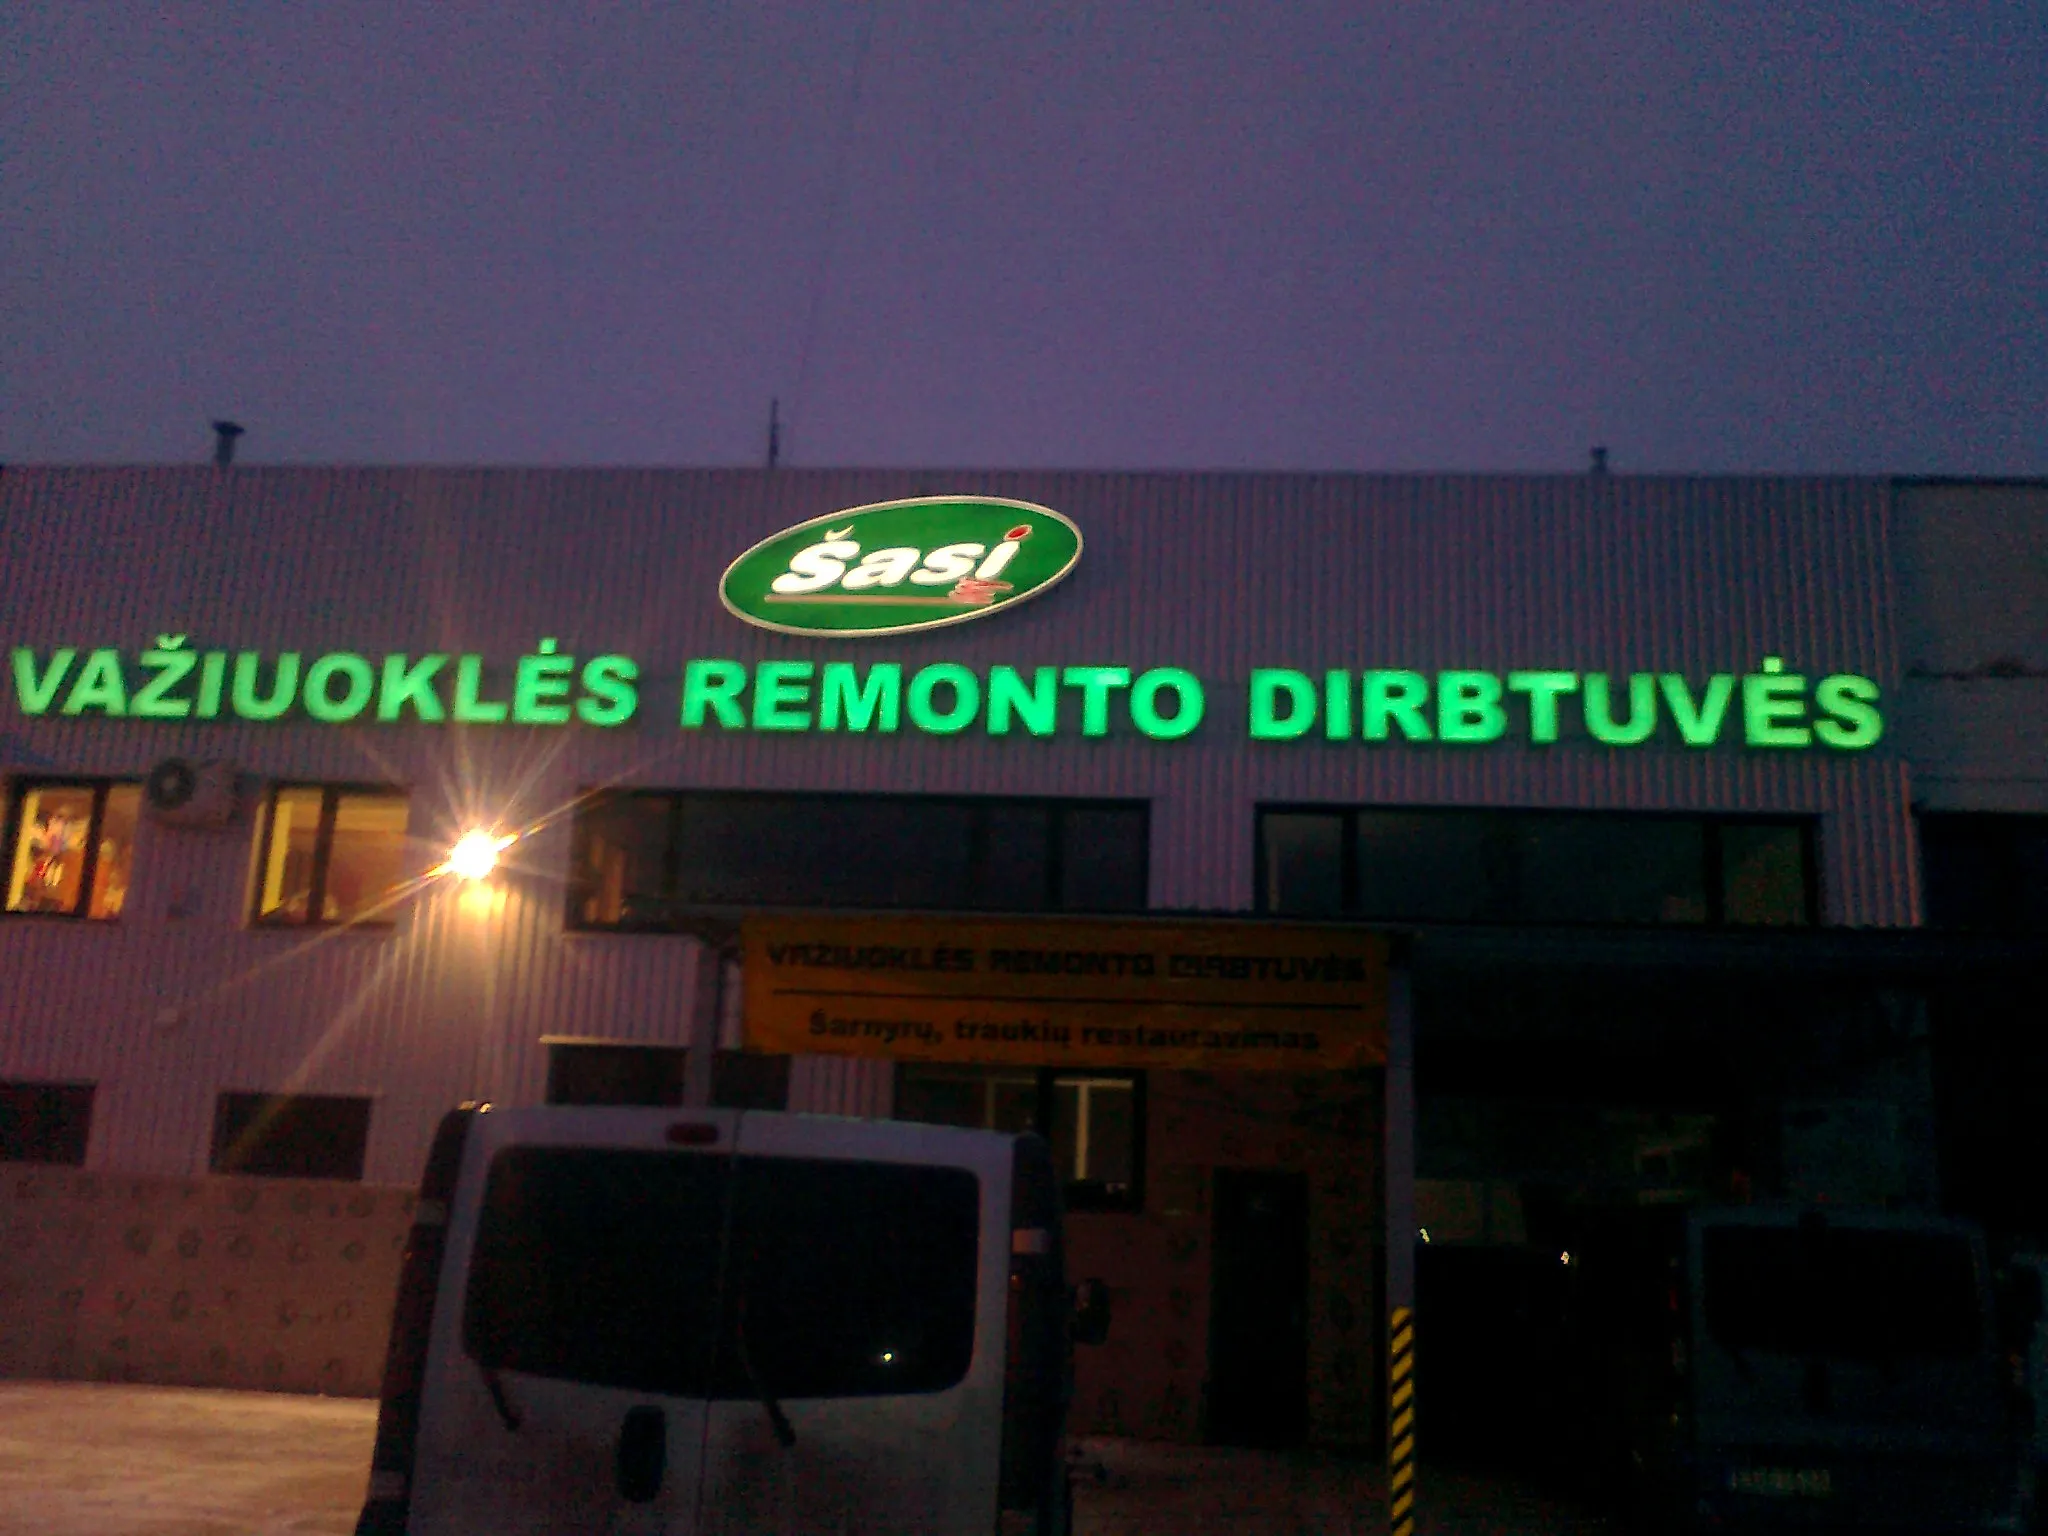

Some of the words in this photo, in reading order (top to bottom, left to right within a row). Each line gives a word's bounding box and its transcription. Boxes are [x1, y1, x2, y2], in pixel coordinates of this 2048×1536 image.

[771, 523, 1033, 595] Šasi
[12, 633, 639, 726] VAŽIUOKLĖS
[680, 659, 1205, 740] REMONTO
[1249, 657, 1884, 749] DIRBTUVĖS
